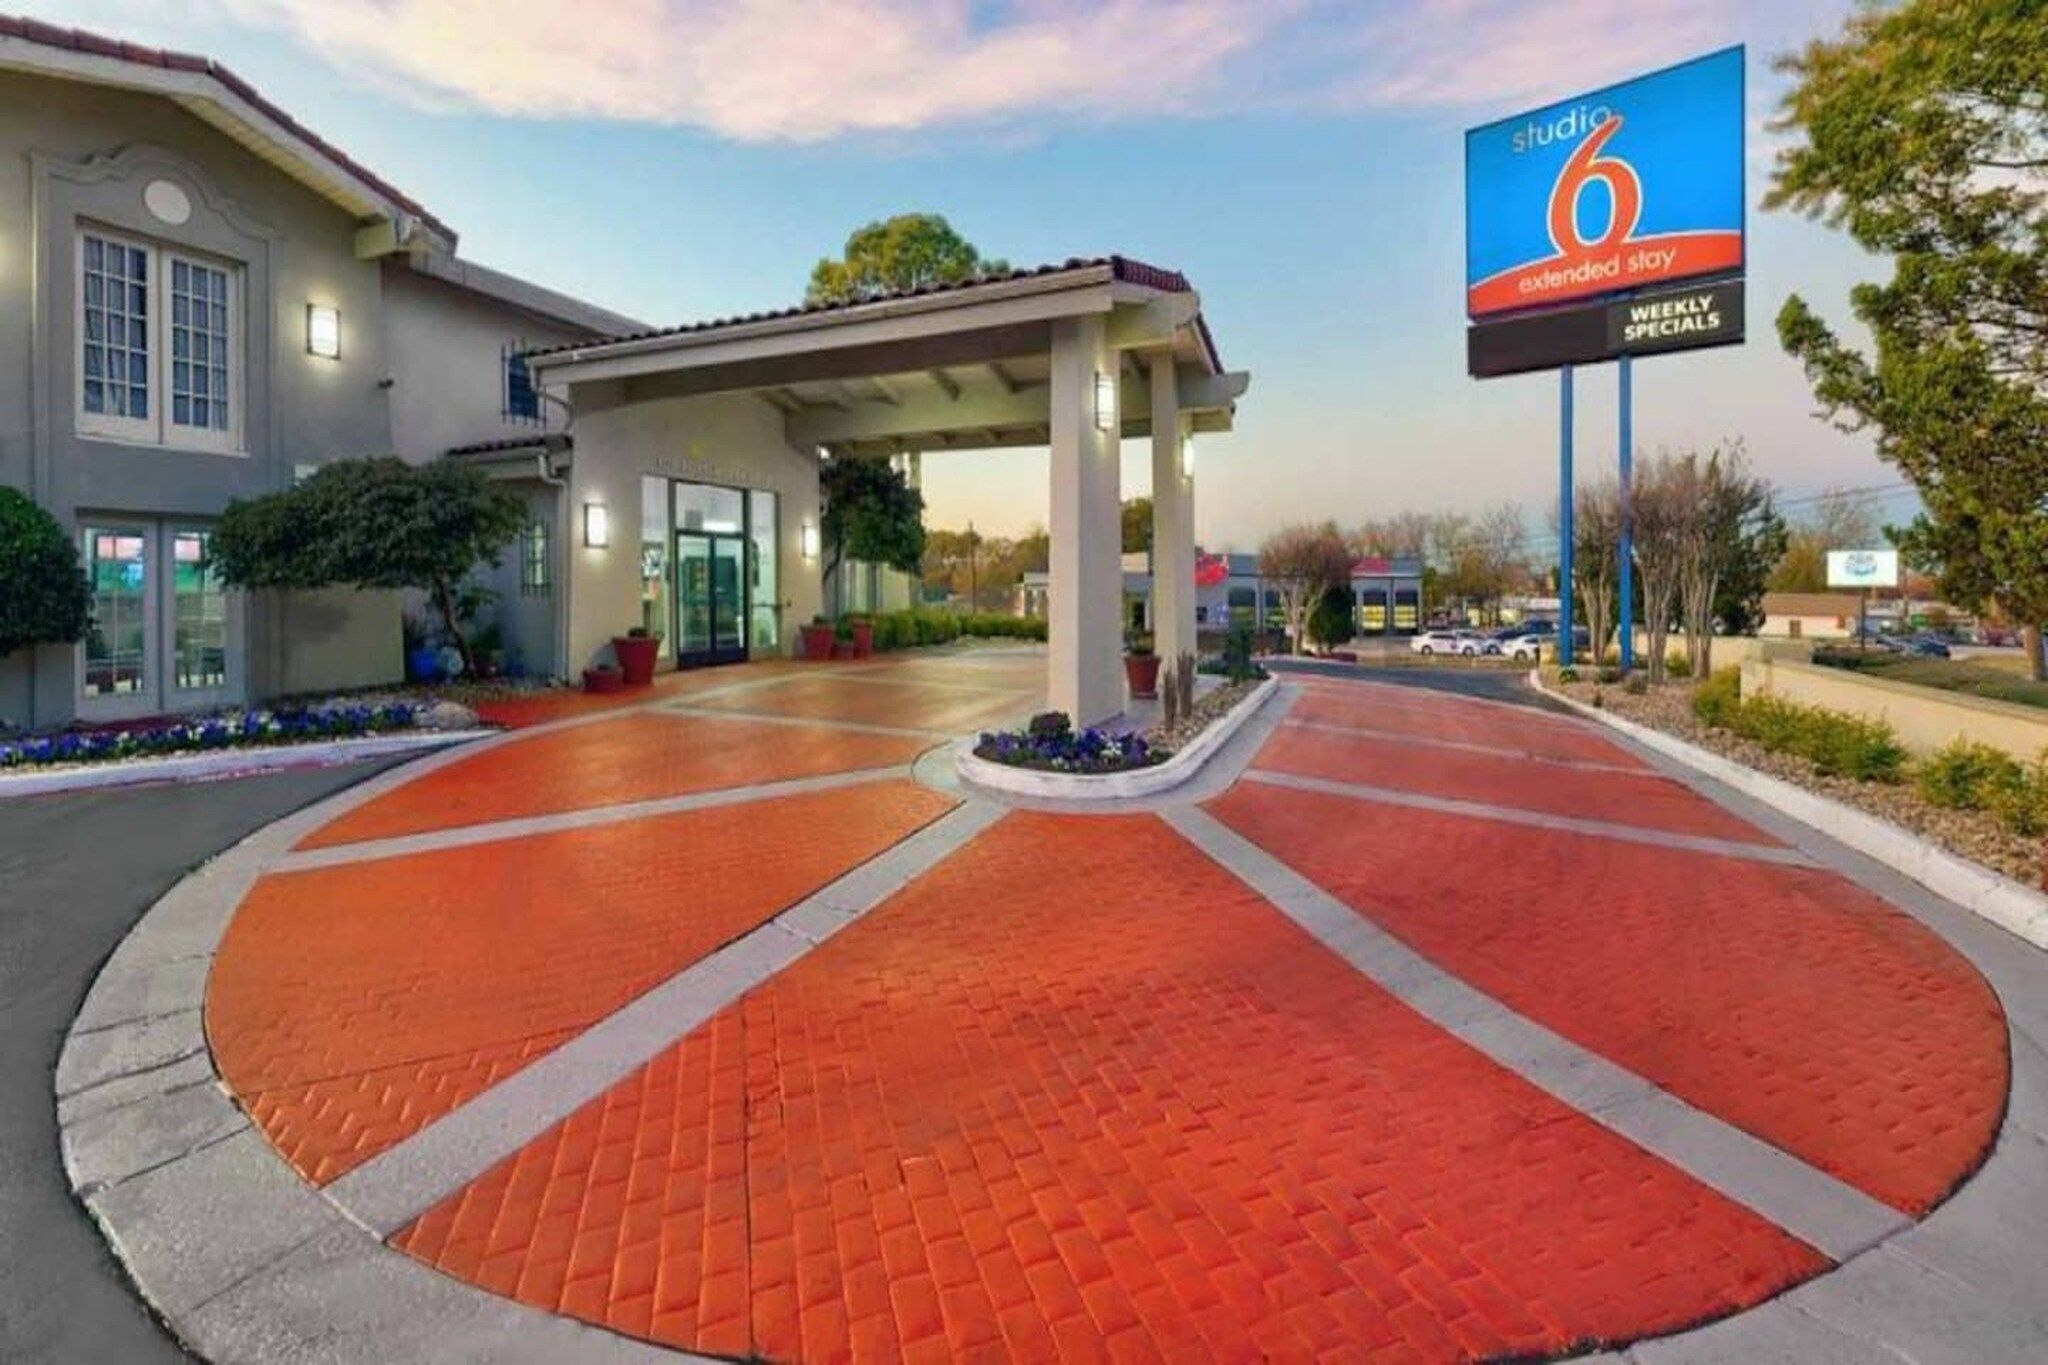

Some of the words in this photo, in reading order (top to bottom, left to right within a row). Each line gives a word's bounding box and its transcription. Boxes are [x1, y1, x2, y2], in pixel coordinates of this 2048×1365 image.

[1512, 106, 1612, 153] studio
[1546, 115, 1643, 256] 6
[1518, 254, 1620, 293] extended
[1627, 247, 1677, 273] stay
[1624, 311, 1721, 341] SPECIALS
[1629, 294, 1714, 322] WEEKLY
